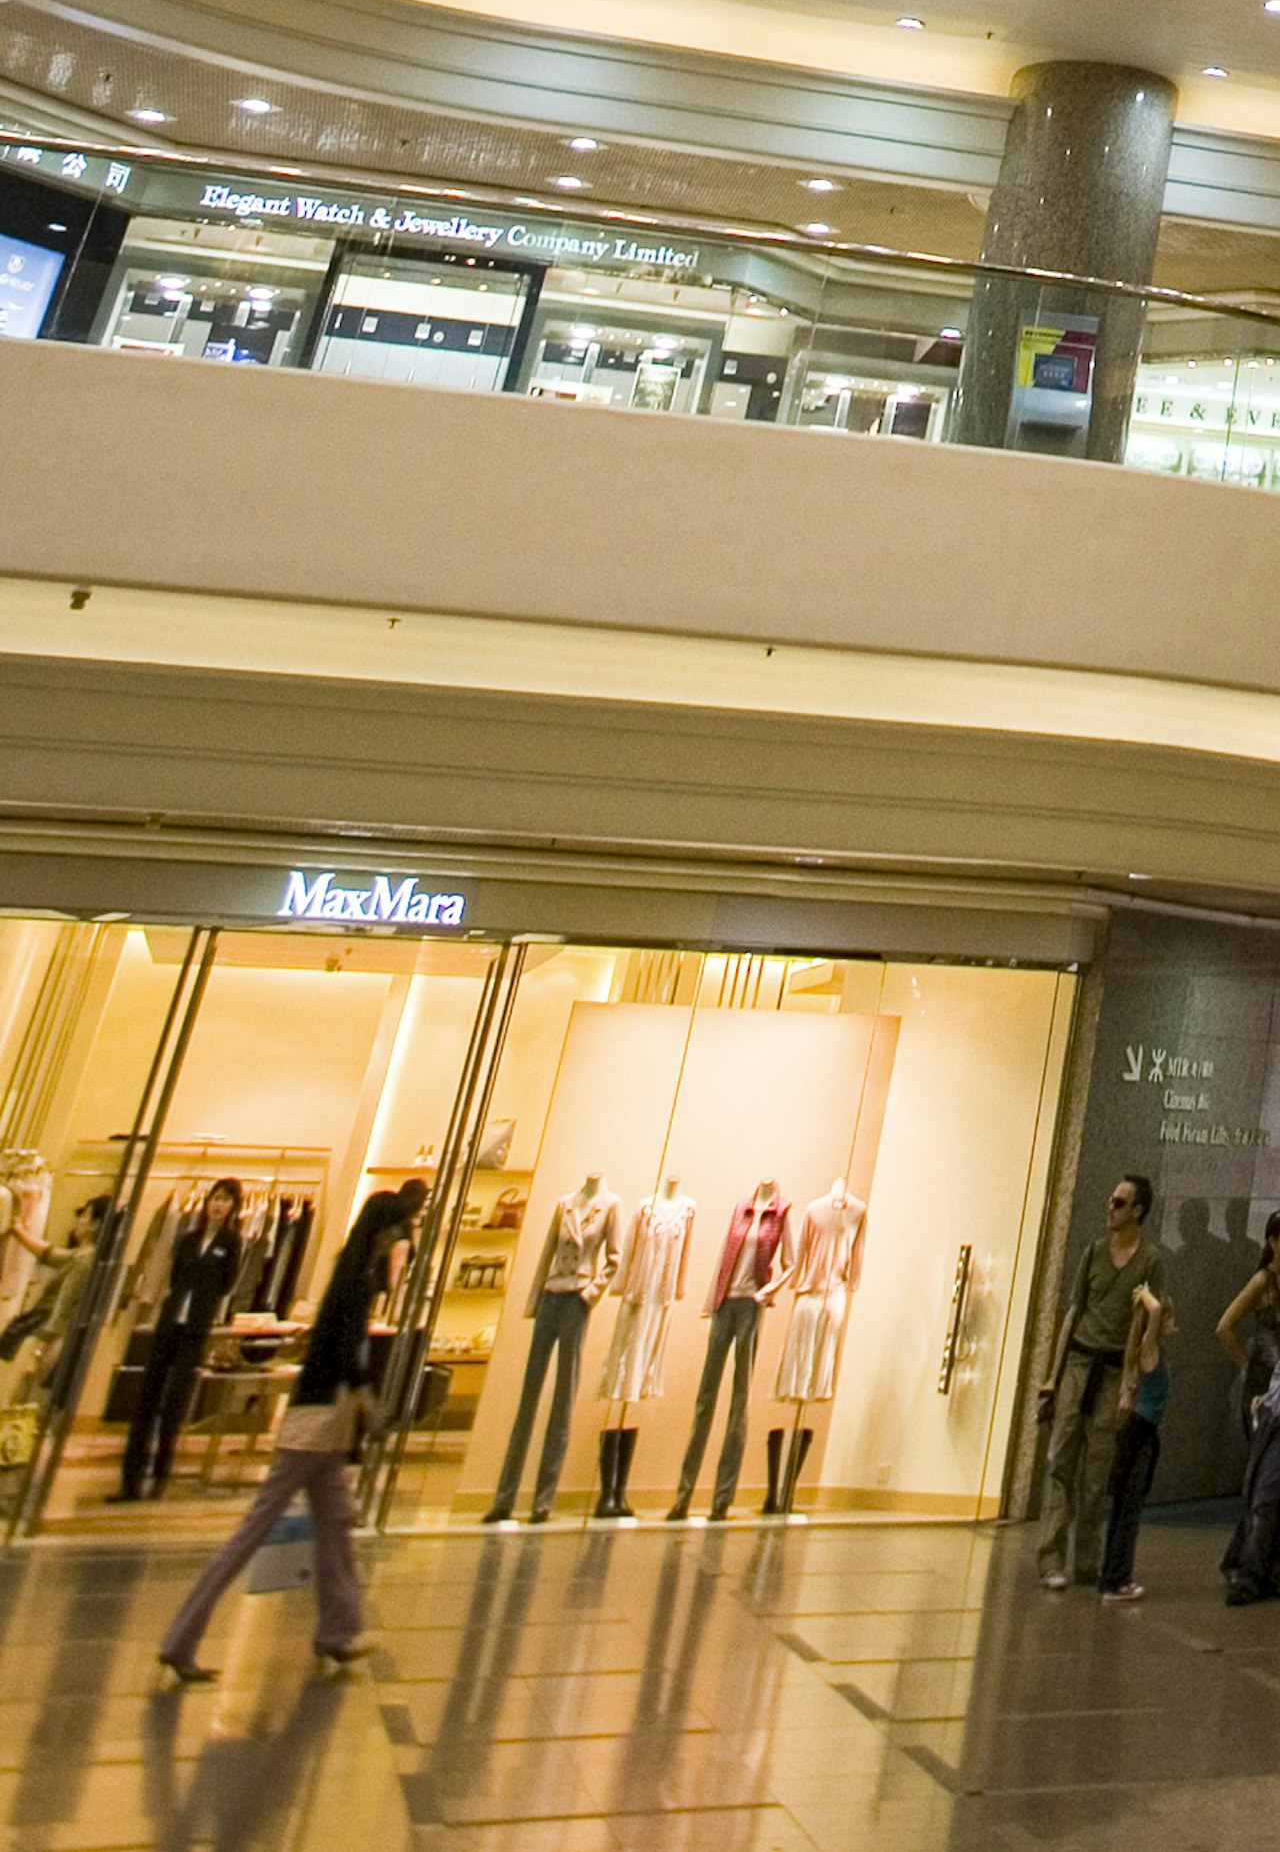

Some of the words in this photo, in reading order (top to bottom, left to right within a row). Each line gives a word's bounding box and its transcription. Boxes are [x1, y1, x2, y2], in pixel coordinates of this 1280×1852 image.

[201, 185, 291, 216] Elegant
[296, 196, 364, 226] Watch
[369, 207, 392, 229] &
[394, 210, 504, 248] Jewellery
[507, 225, 608, 261] Company
[612, 239, 699, 269] Limited
[277, 870, 465, 926] MaxMara
